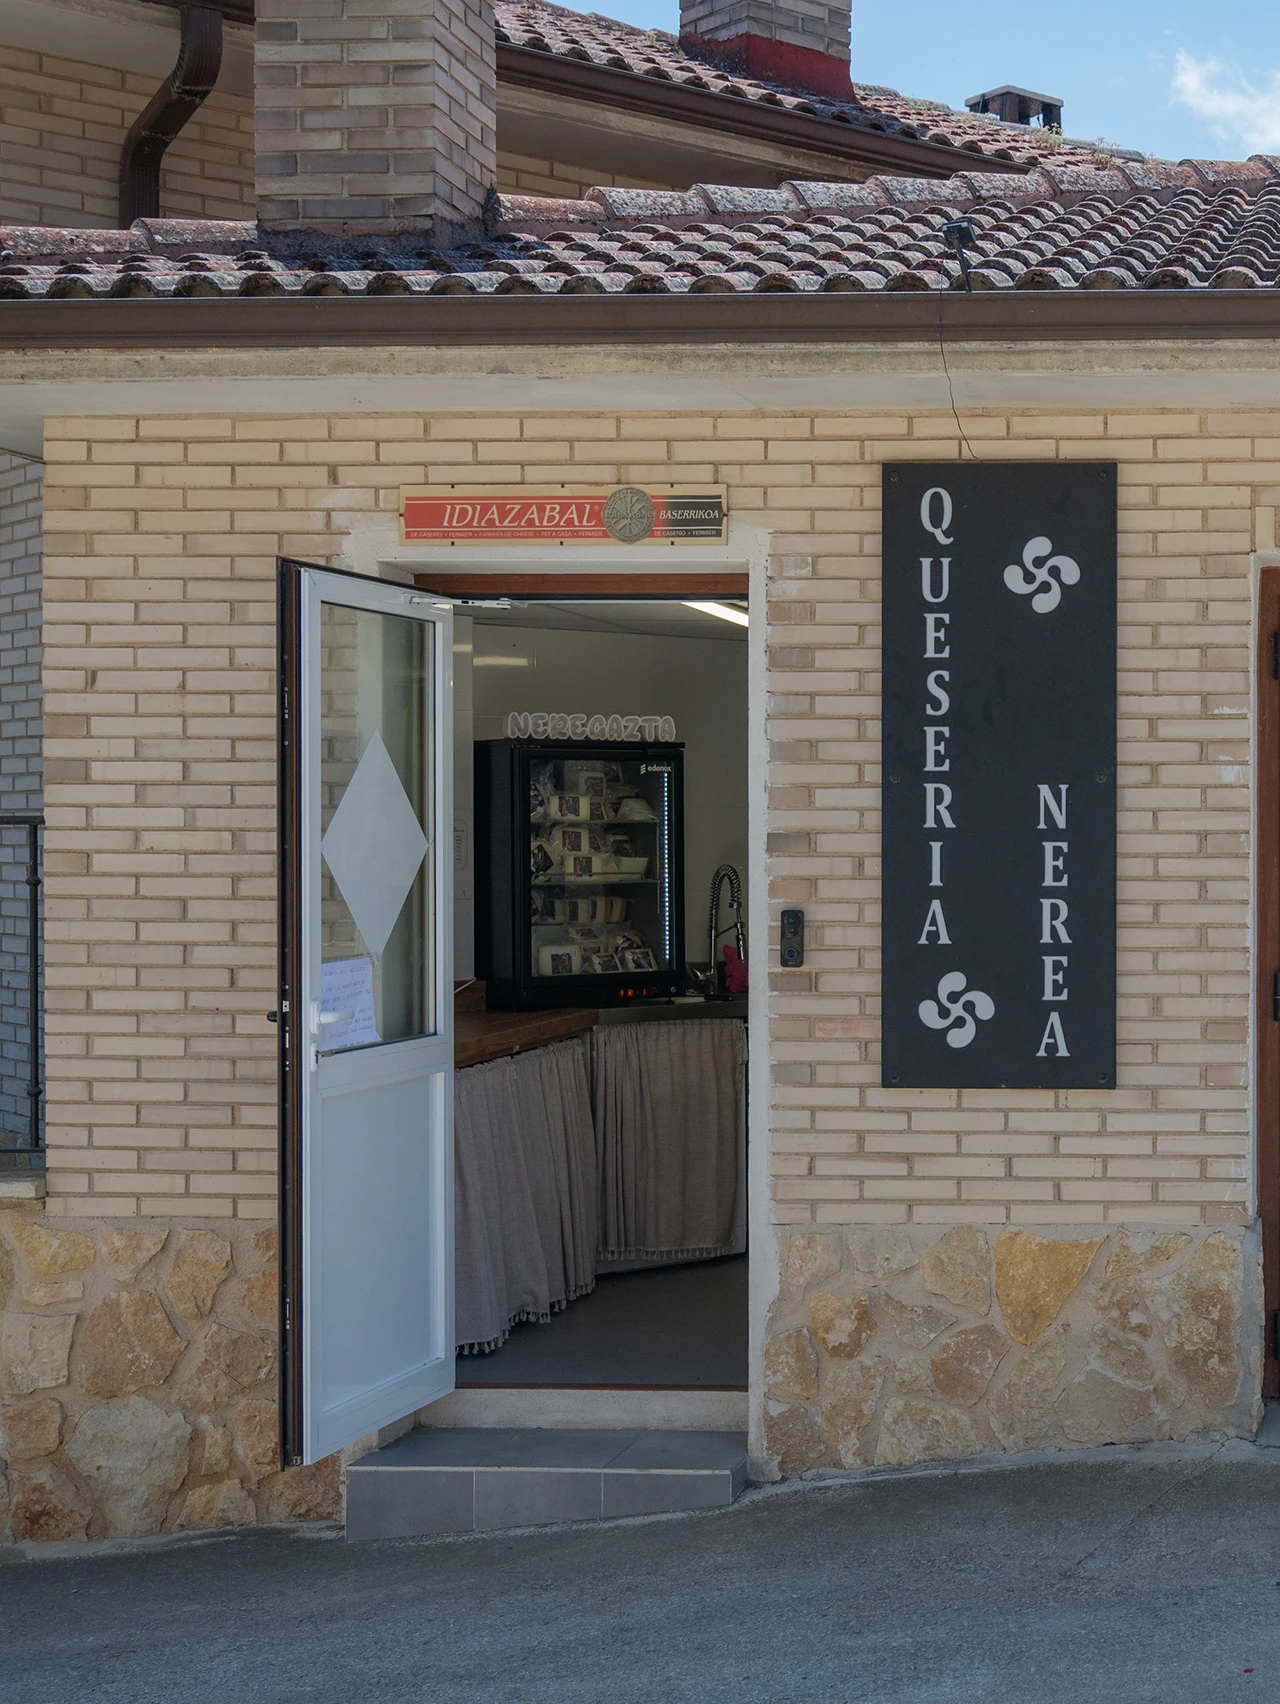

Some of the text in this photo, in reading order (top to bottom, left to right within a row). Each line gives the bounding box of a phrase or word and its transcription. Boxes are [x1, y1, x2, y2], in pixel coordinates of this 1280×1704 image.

[659, 509, 719, 520] BASERRIKOA
[508, 711, 676, 742] NEREGAZTA
[918, 487, 956, 944] QUESERIA
[1036, 784, 1072, 1057] NEREA
